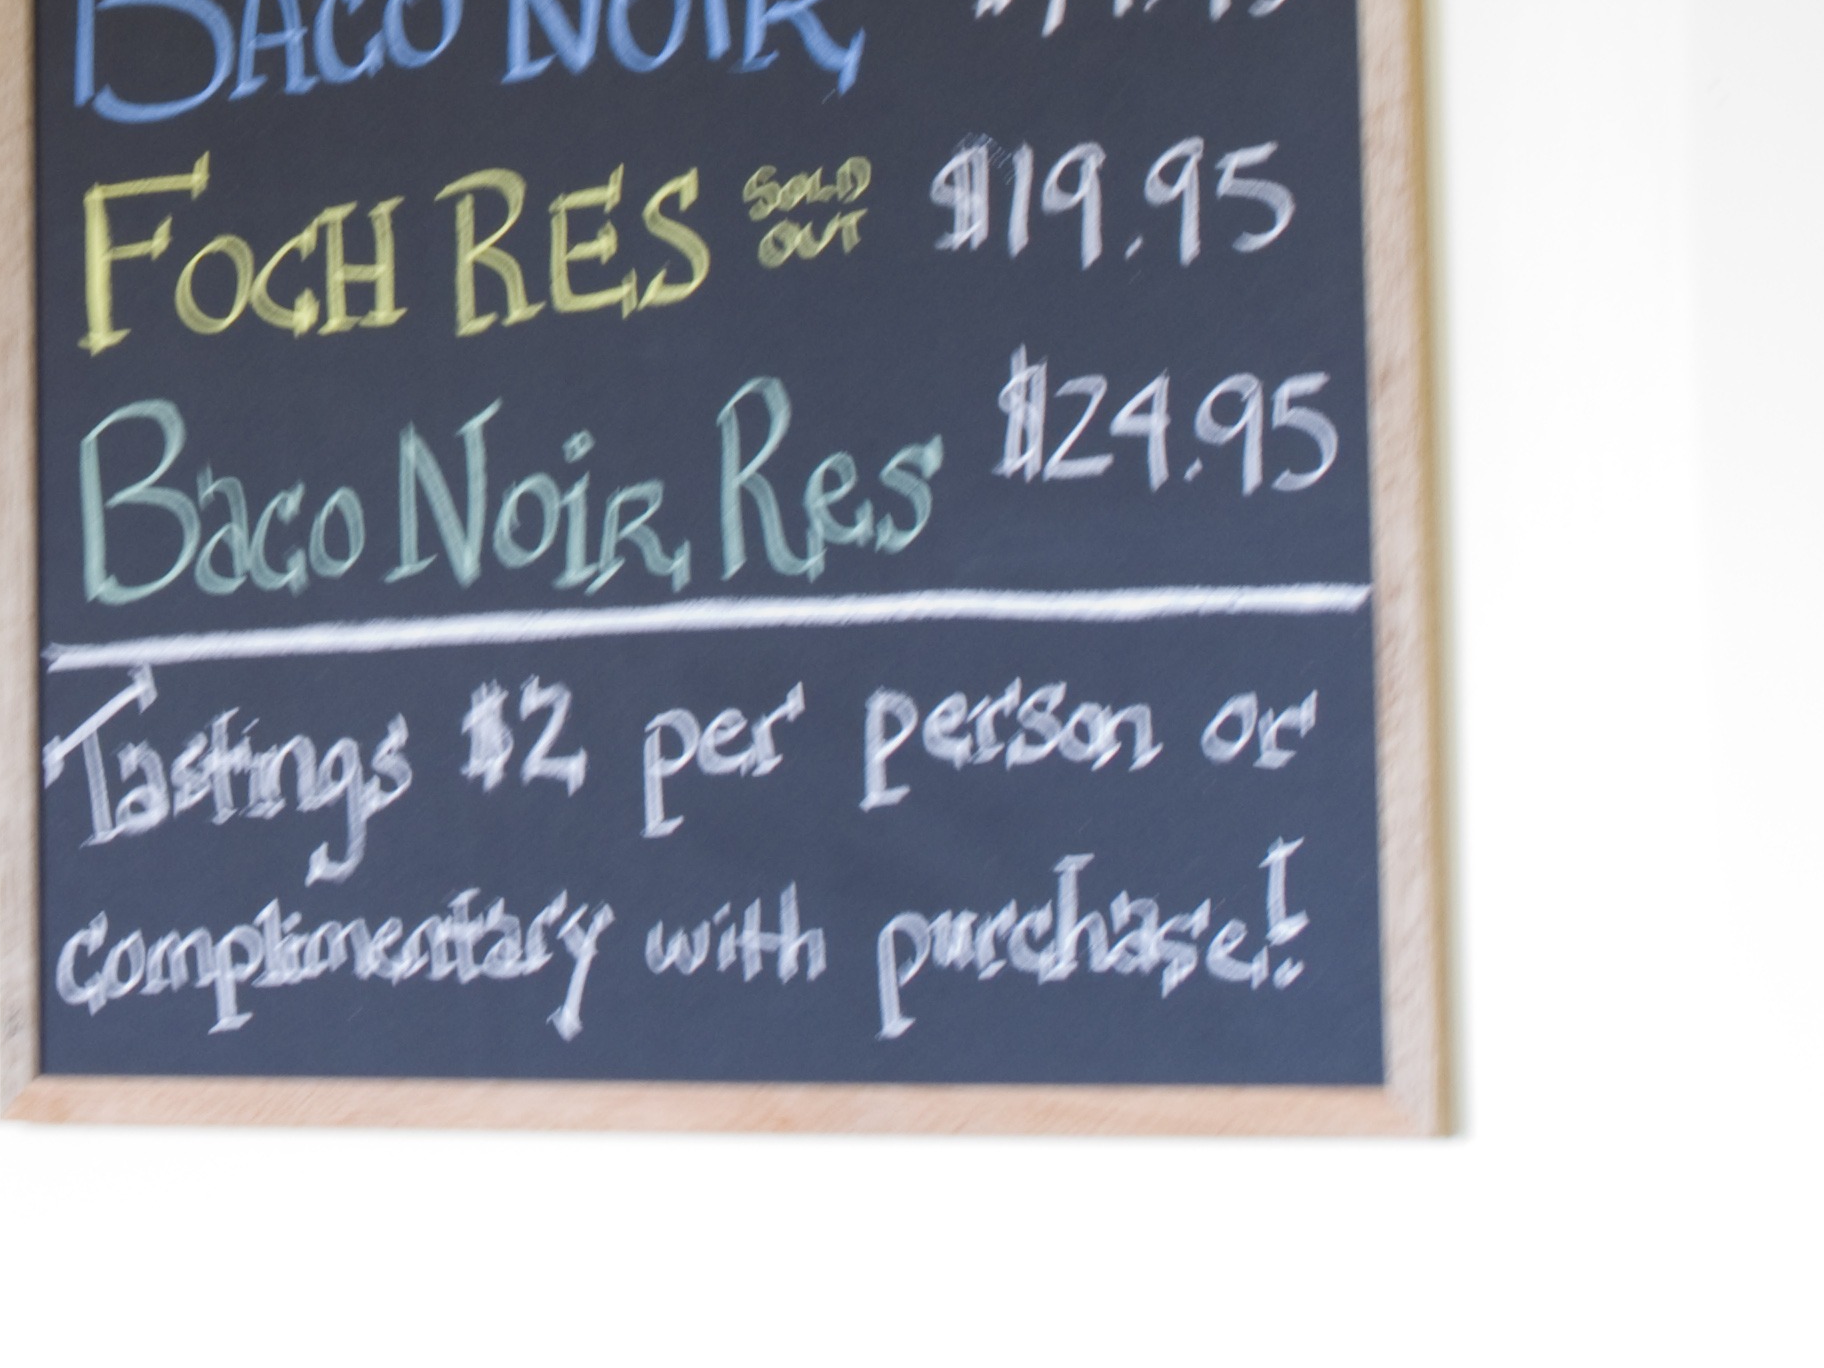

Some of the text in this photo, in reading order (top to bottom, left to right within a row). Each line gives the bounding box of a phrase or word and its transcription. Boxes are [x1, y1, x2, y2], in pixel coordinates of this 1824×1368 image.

[77, 151, 711, 356] FOCH RES
[742, 155, 872, 221] SOLD
[757, 207, 868, 269] OUT
[930, 134, 1295, 268] $19.95
[78, 399, 365, 606] Baco
[716, 376, 943, 587] Res
[993, 345, 1338, 495] $24.95
[43, 662, 1319, 884] Tastings $2 per person or
[55, 837, 1310, 1040] complimentary with purchase!
